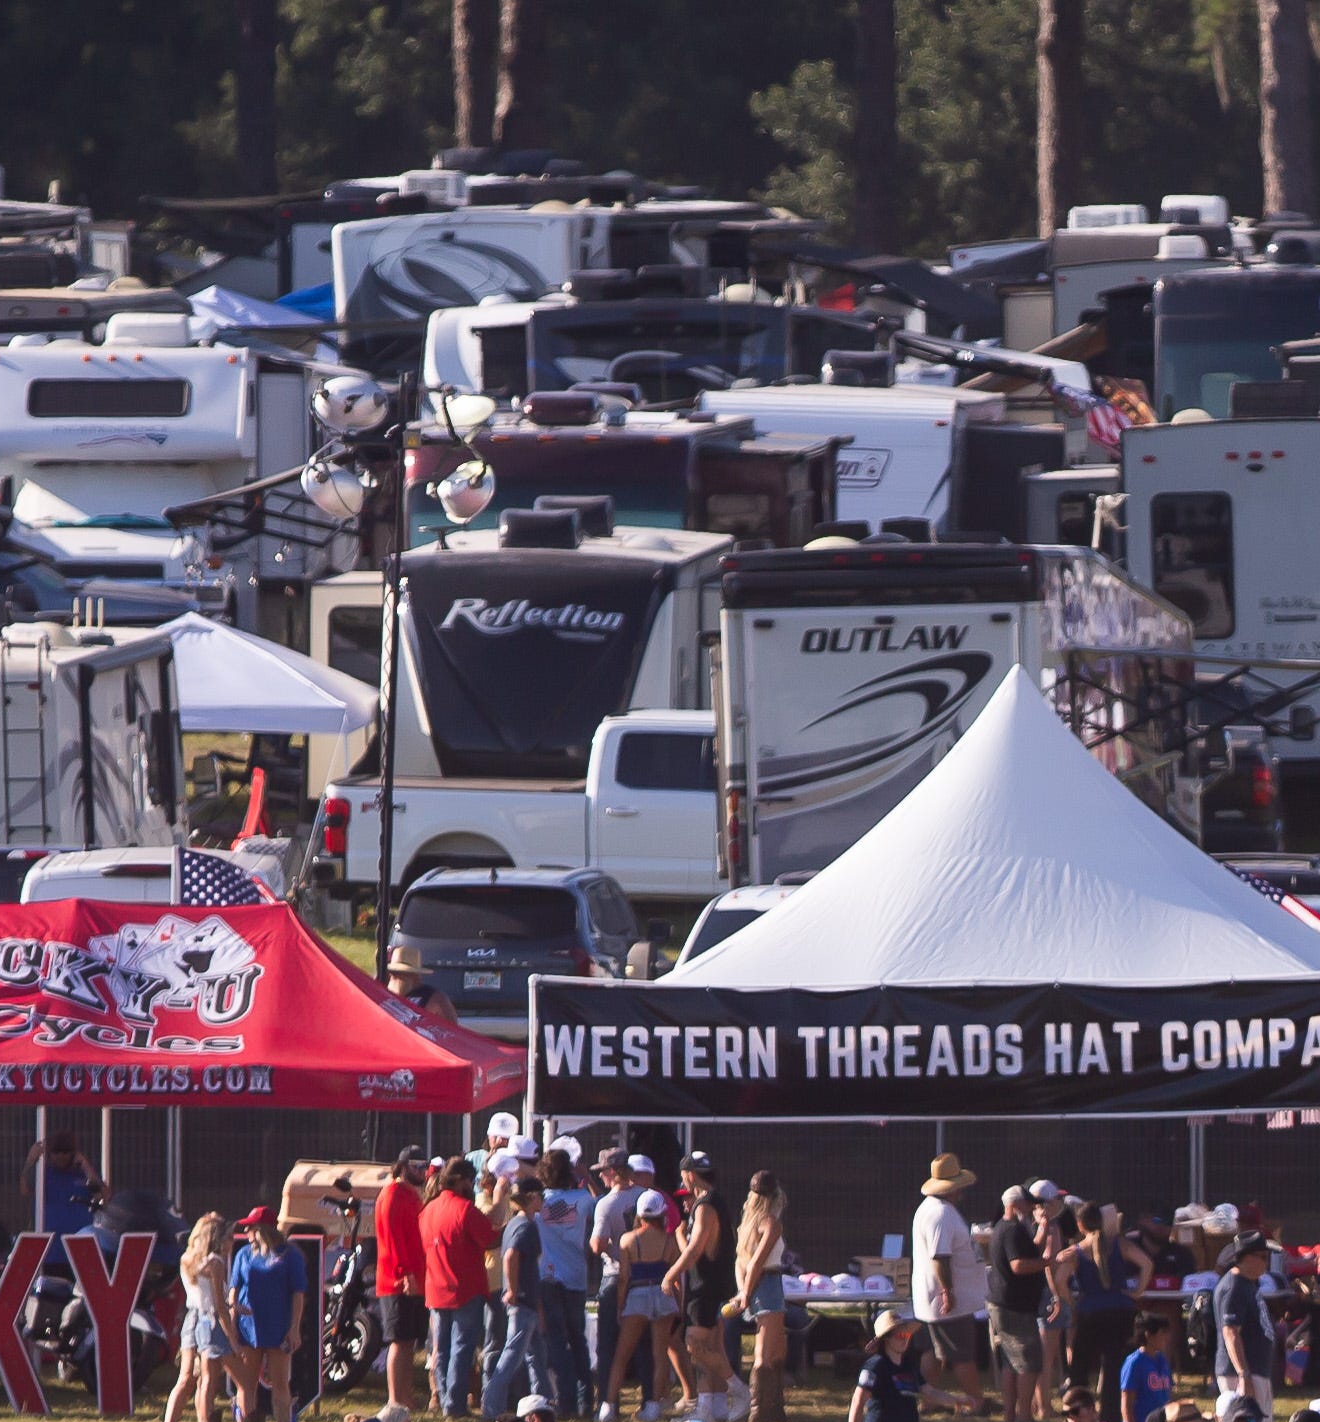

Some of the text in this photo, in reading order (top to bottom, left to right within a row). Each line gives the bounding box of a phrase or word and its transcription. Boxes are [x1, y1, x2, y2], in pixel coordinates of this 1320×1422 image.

[439, 597, 627, 636] Reflection
[800, 625, 970, 653] OUTLAW
[543, 1024, 778, 1078] WESTERN
[798, 1024, 1025, 1079] THREADS
[1044, 1021, 1142, 1075] HAT
